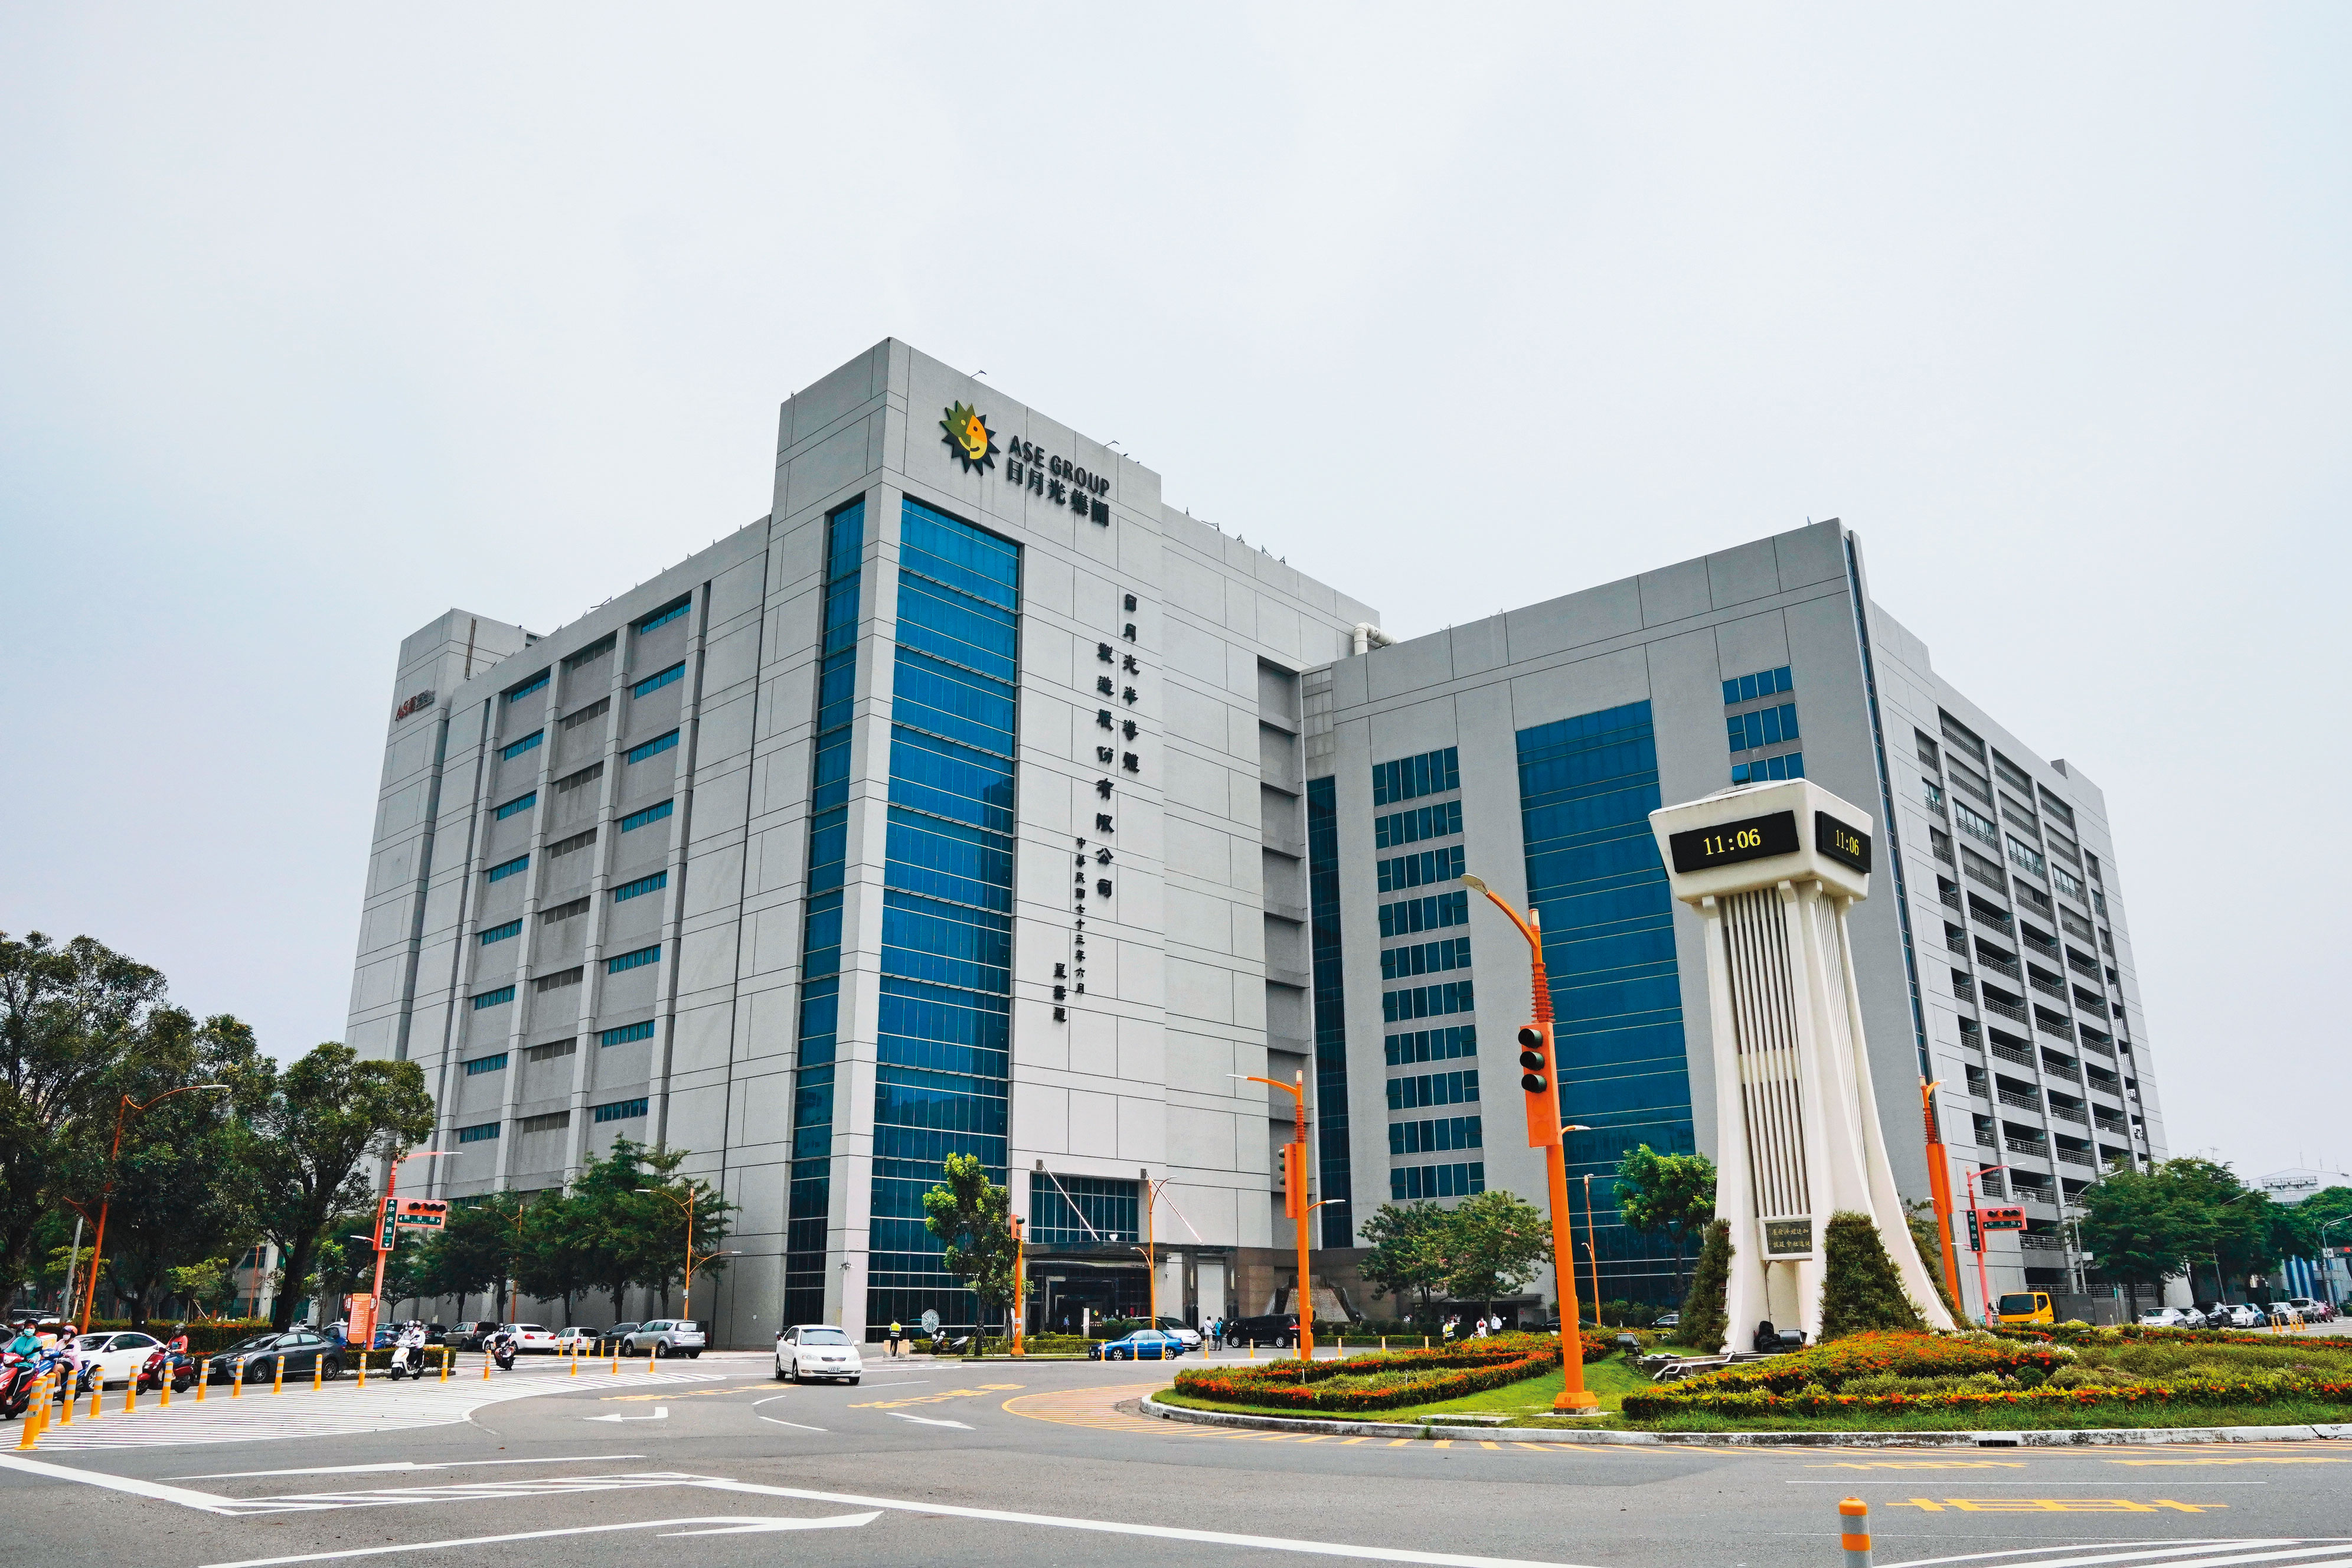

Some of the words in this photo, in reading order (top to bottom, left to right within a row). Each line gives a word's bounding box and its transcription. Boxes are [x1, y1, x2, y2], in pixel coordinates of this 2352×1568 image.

[1008, 457, 1109, 526] 日月光集團
[1009, 435, 1044, 468] ASE
[1051, 455, 1110, 496] GROUP
[1123, 593, 1140, 773] 日月光半導體
[1096, 642, 1115, 898] 製造股份有限公司
[1703, 828, 1762, 856] 11:06
[1835, 829, 1860, 856] 11:06
[385, 1206, 395, 1233] 中央路
